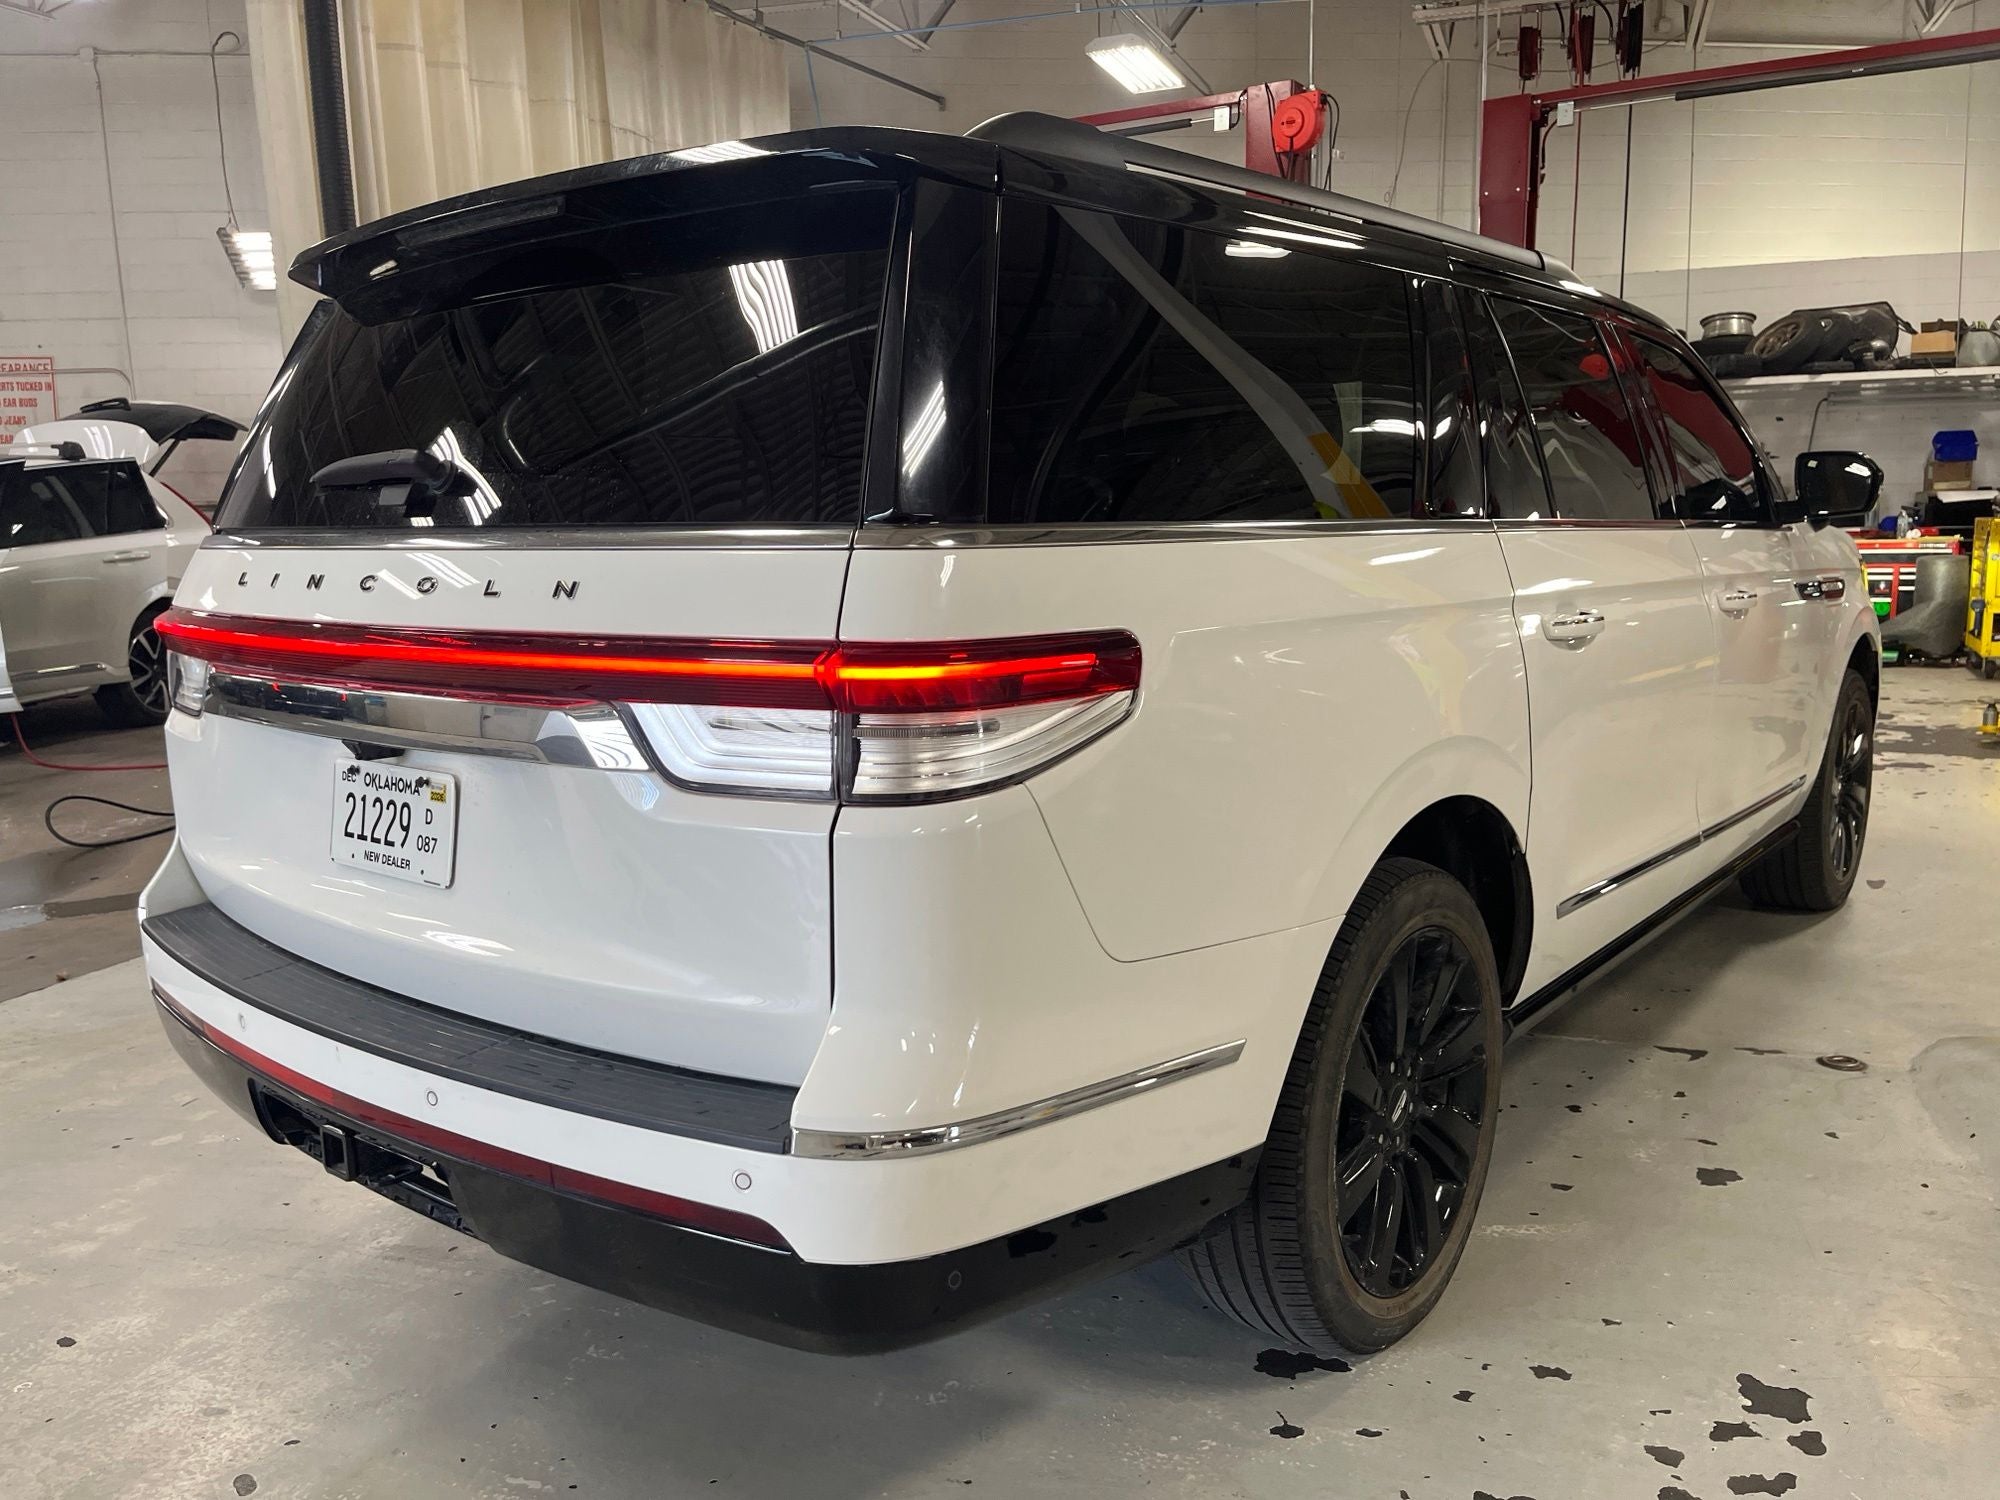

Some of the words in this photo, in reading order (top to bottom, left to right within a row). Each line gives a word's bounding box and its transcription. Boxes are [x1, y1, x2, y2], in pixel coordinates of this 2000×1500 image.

[16, 382, 42, 391] TUCKED
[44, 382, 52, 391] IN
[3, 398, 17, 407] EAR
[19, 398, 37, 407] BUDS
[238, 572, 580, 600] LINCOLN
[342, 771, 356, 783] DEC
[364, 772, 420, 796] OKLAHOMA
[344, 792, 411, 848] 21229
[425, 808, 433, 825] D
[417, 834, 437, 854] 087
[364, 850, 380, 864] NEW
[381, 854, 410, 870] DEALER
